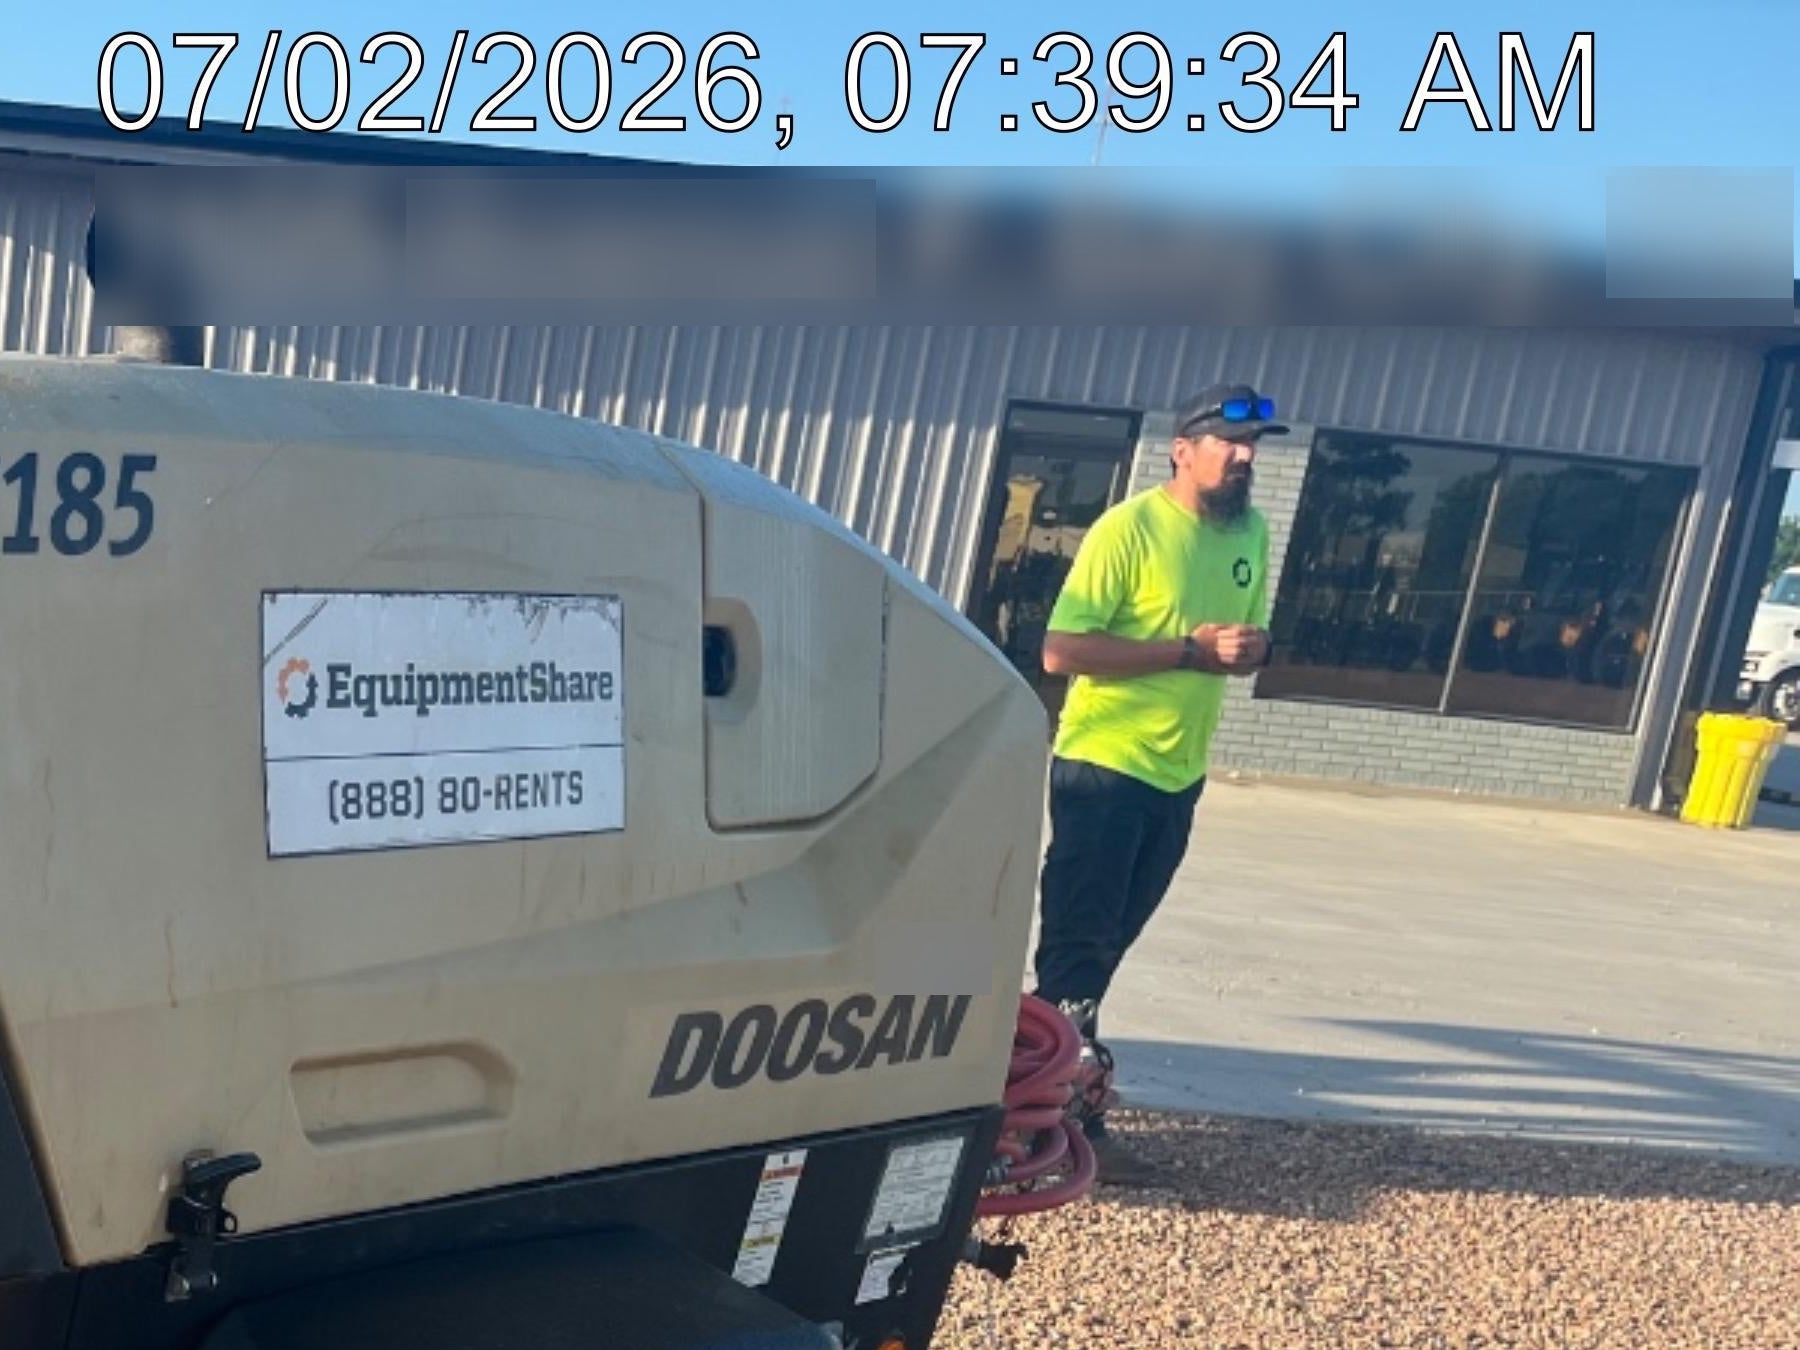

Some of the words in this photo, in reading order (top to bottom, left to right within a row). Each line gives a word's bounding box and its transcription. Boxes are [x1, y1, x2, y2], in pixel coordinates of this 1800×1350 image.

[326, 661, 614, 718] EquipmentShare
[328, 776, 424, 825] (888)
[438, 770, 584, 814] 80-RENTS
[648, 993, 973, 1098] DOOSAN
